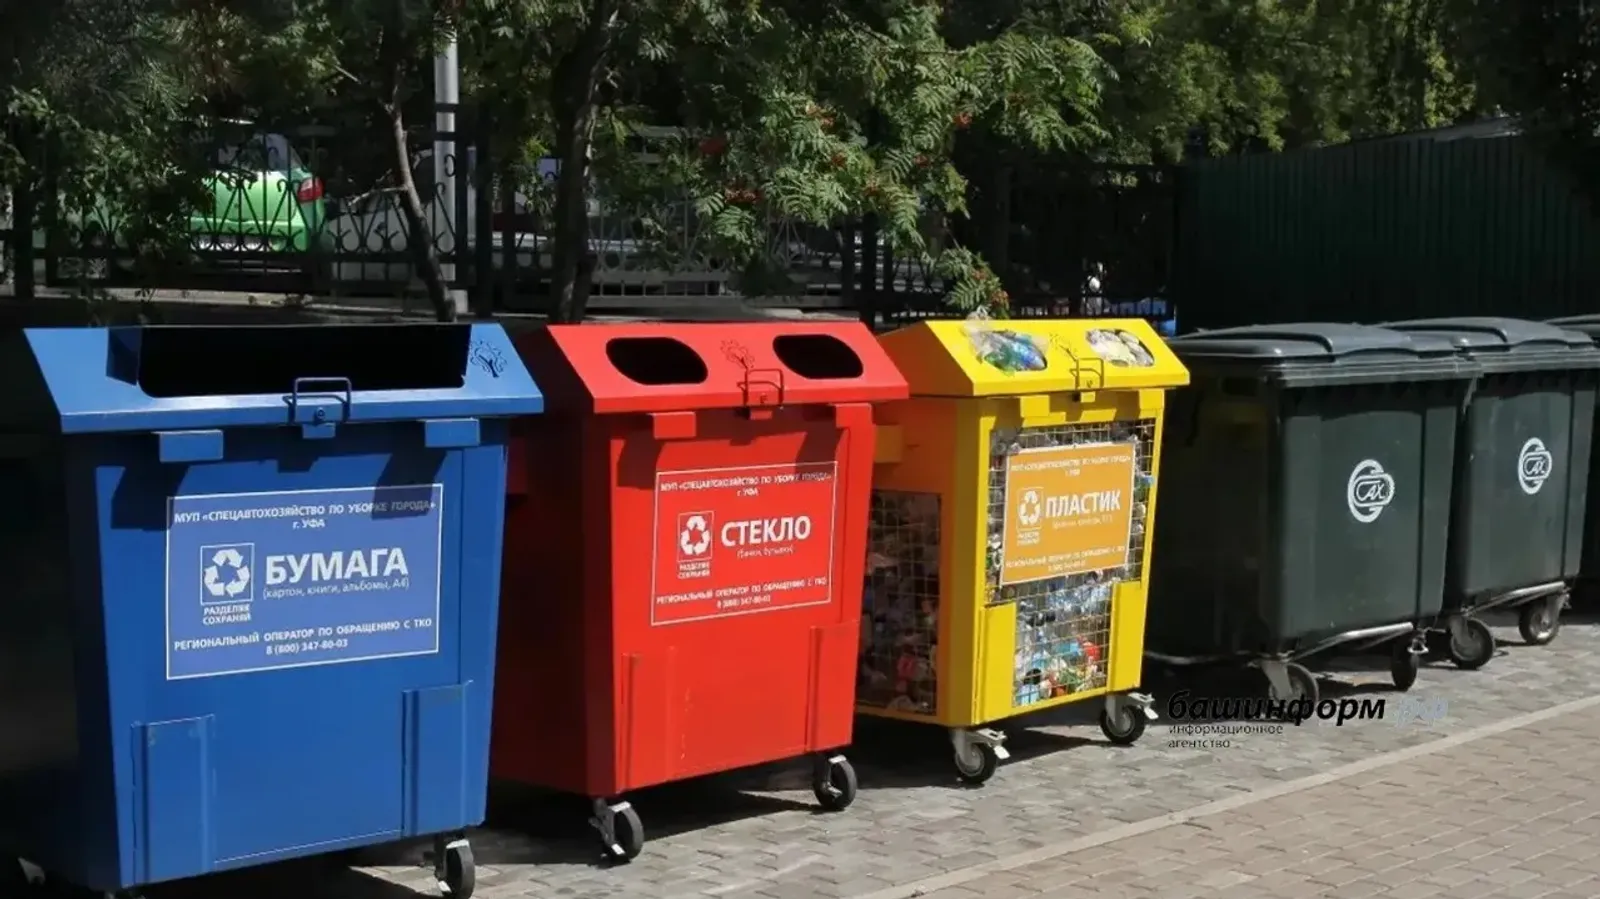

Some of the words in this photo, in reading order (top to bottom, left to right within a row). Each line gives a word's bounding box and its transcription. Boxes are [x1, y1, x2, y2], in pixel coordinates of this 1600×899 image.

[174, 512, 200, 523] МУП
[328, 505, 344, 515] ПО
[348, 502, 388, 514] УБОРКЕ
[1046, 489, 1121, 518] ПЛАСТИК
[292, 520, 300, 530] г.
[301, 518, 326, 529] УФА
[721, 515, 811, 547] СТЕКЛО
[266, 547, 409, 586] БУМАГА
[263, 586, 305, 600] (картон,
[307, 585, 341, 596] книги,
[342, 579, 391, 593] альбомы,
[174, 631, 260, 651] РЕГИОНАЛЬНЫЙ
[263, 628, 315, 643] ОПЕРАТОР
[318, 626, 333, 637] ПО
[336, 621, 400, 635] ОБРАЩЕНИЮ
[403, 619, 411, 629] С
[414, 617, 432, 628] ТКО
[266, 645, 273, 656] 8
[274, 643, 300, 656] (800)
[301, 639, 348, 652] 347-80-03
